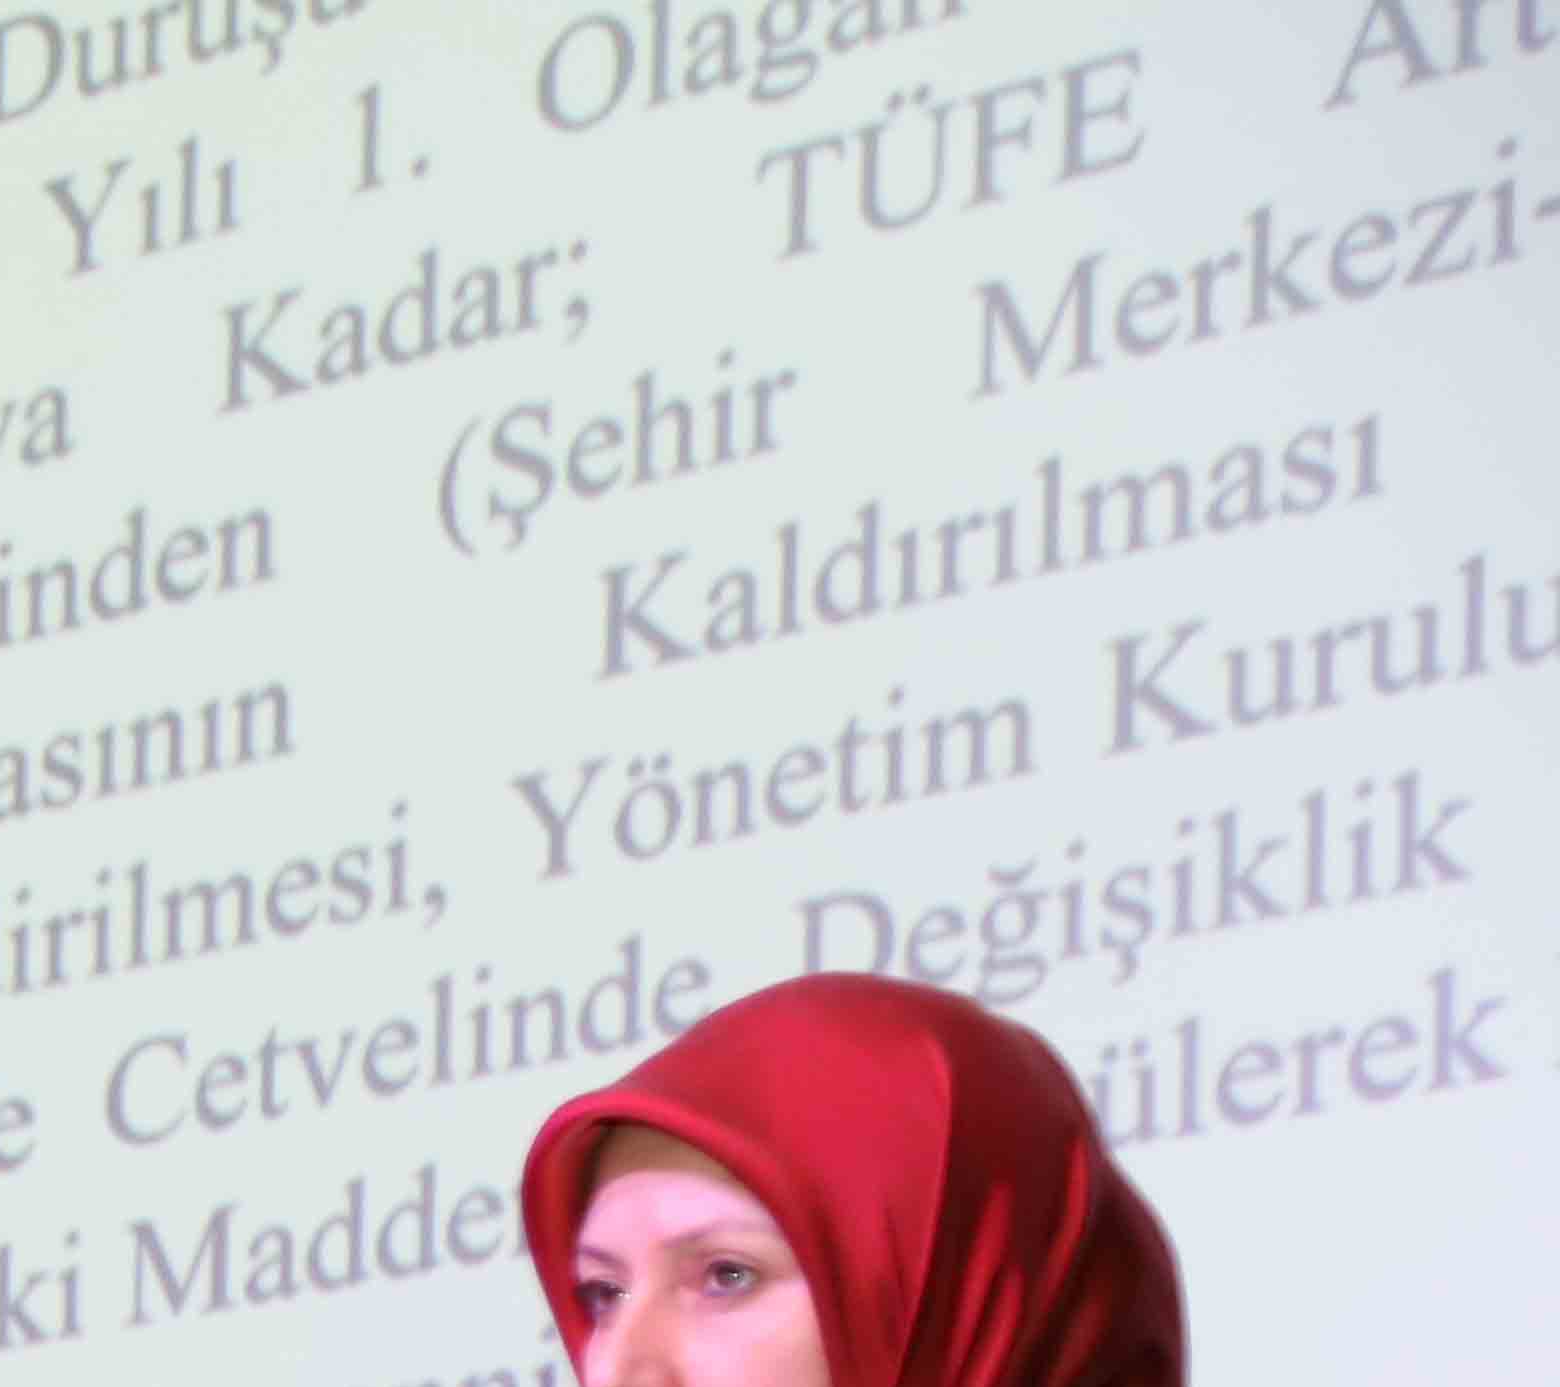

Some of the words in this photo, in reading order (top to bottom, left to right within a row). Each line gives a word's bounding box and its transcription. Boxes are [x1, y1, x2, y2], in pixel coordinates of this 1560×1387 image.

[43, 135, 239, 277] Yılı
[356, 83, 429, 193] 1.
[219, 238, 591, 414] Kadar;
[755, 48, 1144, 260] TÜFE
[437, 348, 798, 557] (Şehir
[597, 415, 1383, 681] Kaldırılması
[510, 685, 1035, 880] Yönetim
[104, 938, 712, 1147] Cetvelinde
[796, 769, 1470, 1006] Değişiklik
[127, 1162, 529, 1327] Madde
